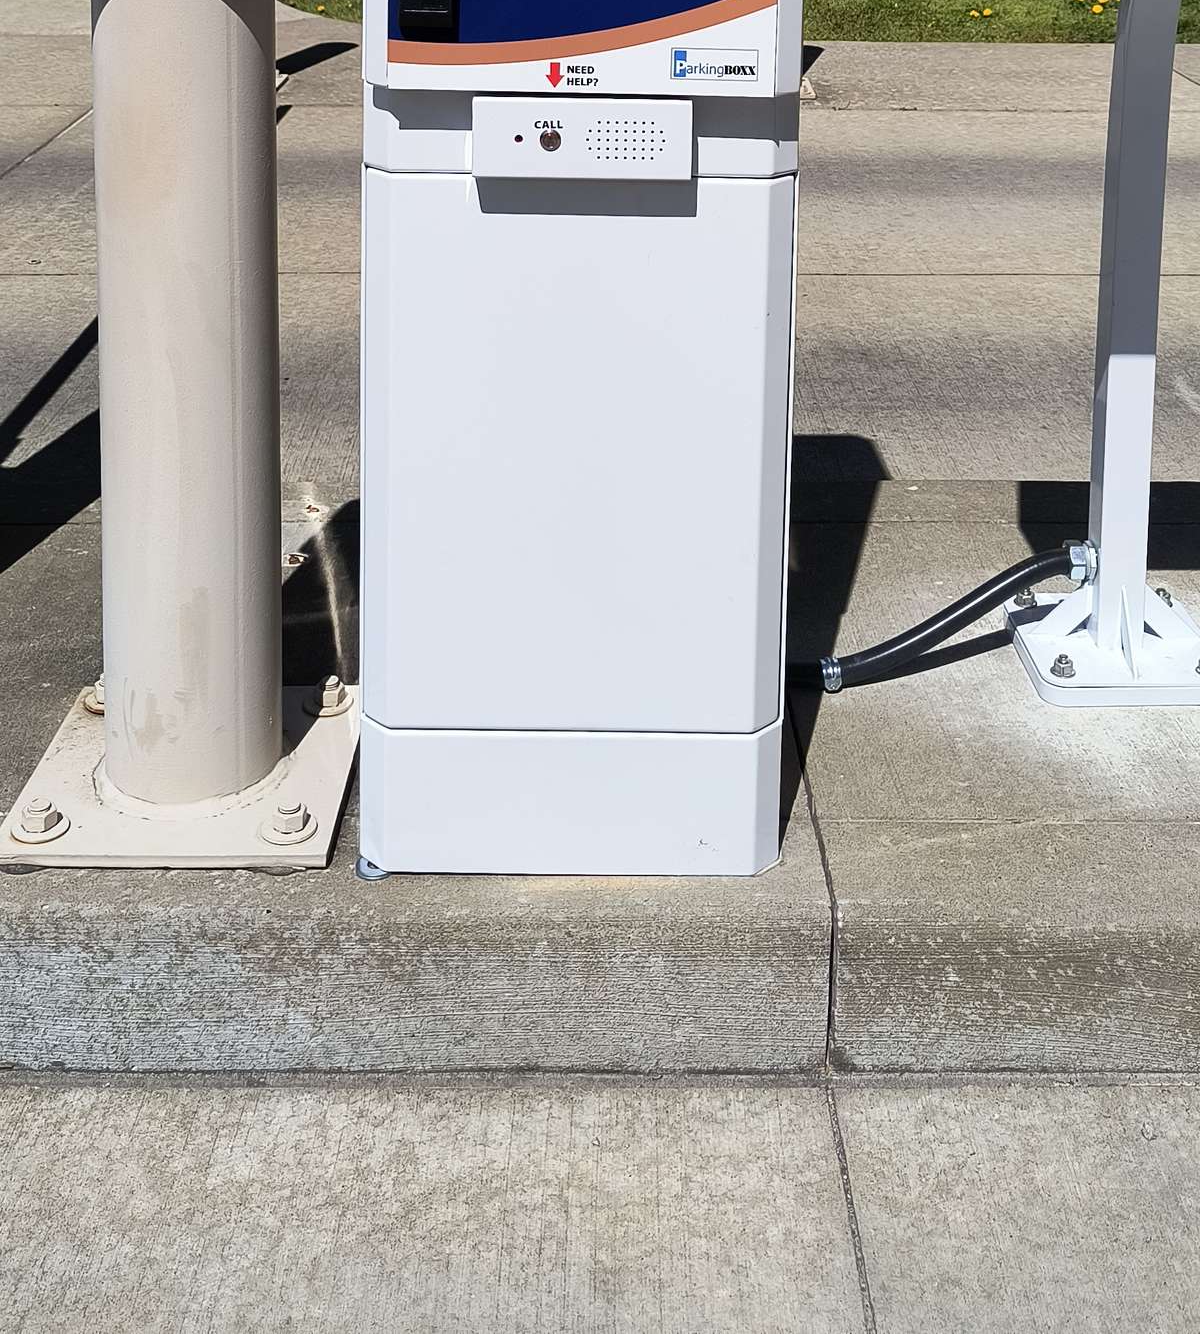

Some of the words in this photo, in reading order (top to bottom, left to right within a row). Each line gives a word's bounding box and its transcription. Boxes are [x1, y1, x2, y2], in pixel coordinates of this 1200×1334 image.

[567, 65, 595, 75] NEED
[567, 77, 598, 87] HELP?
[534, 120, 563, 129] CALL
